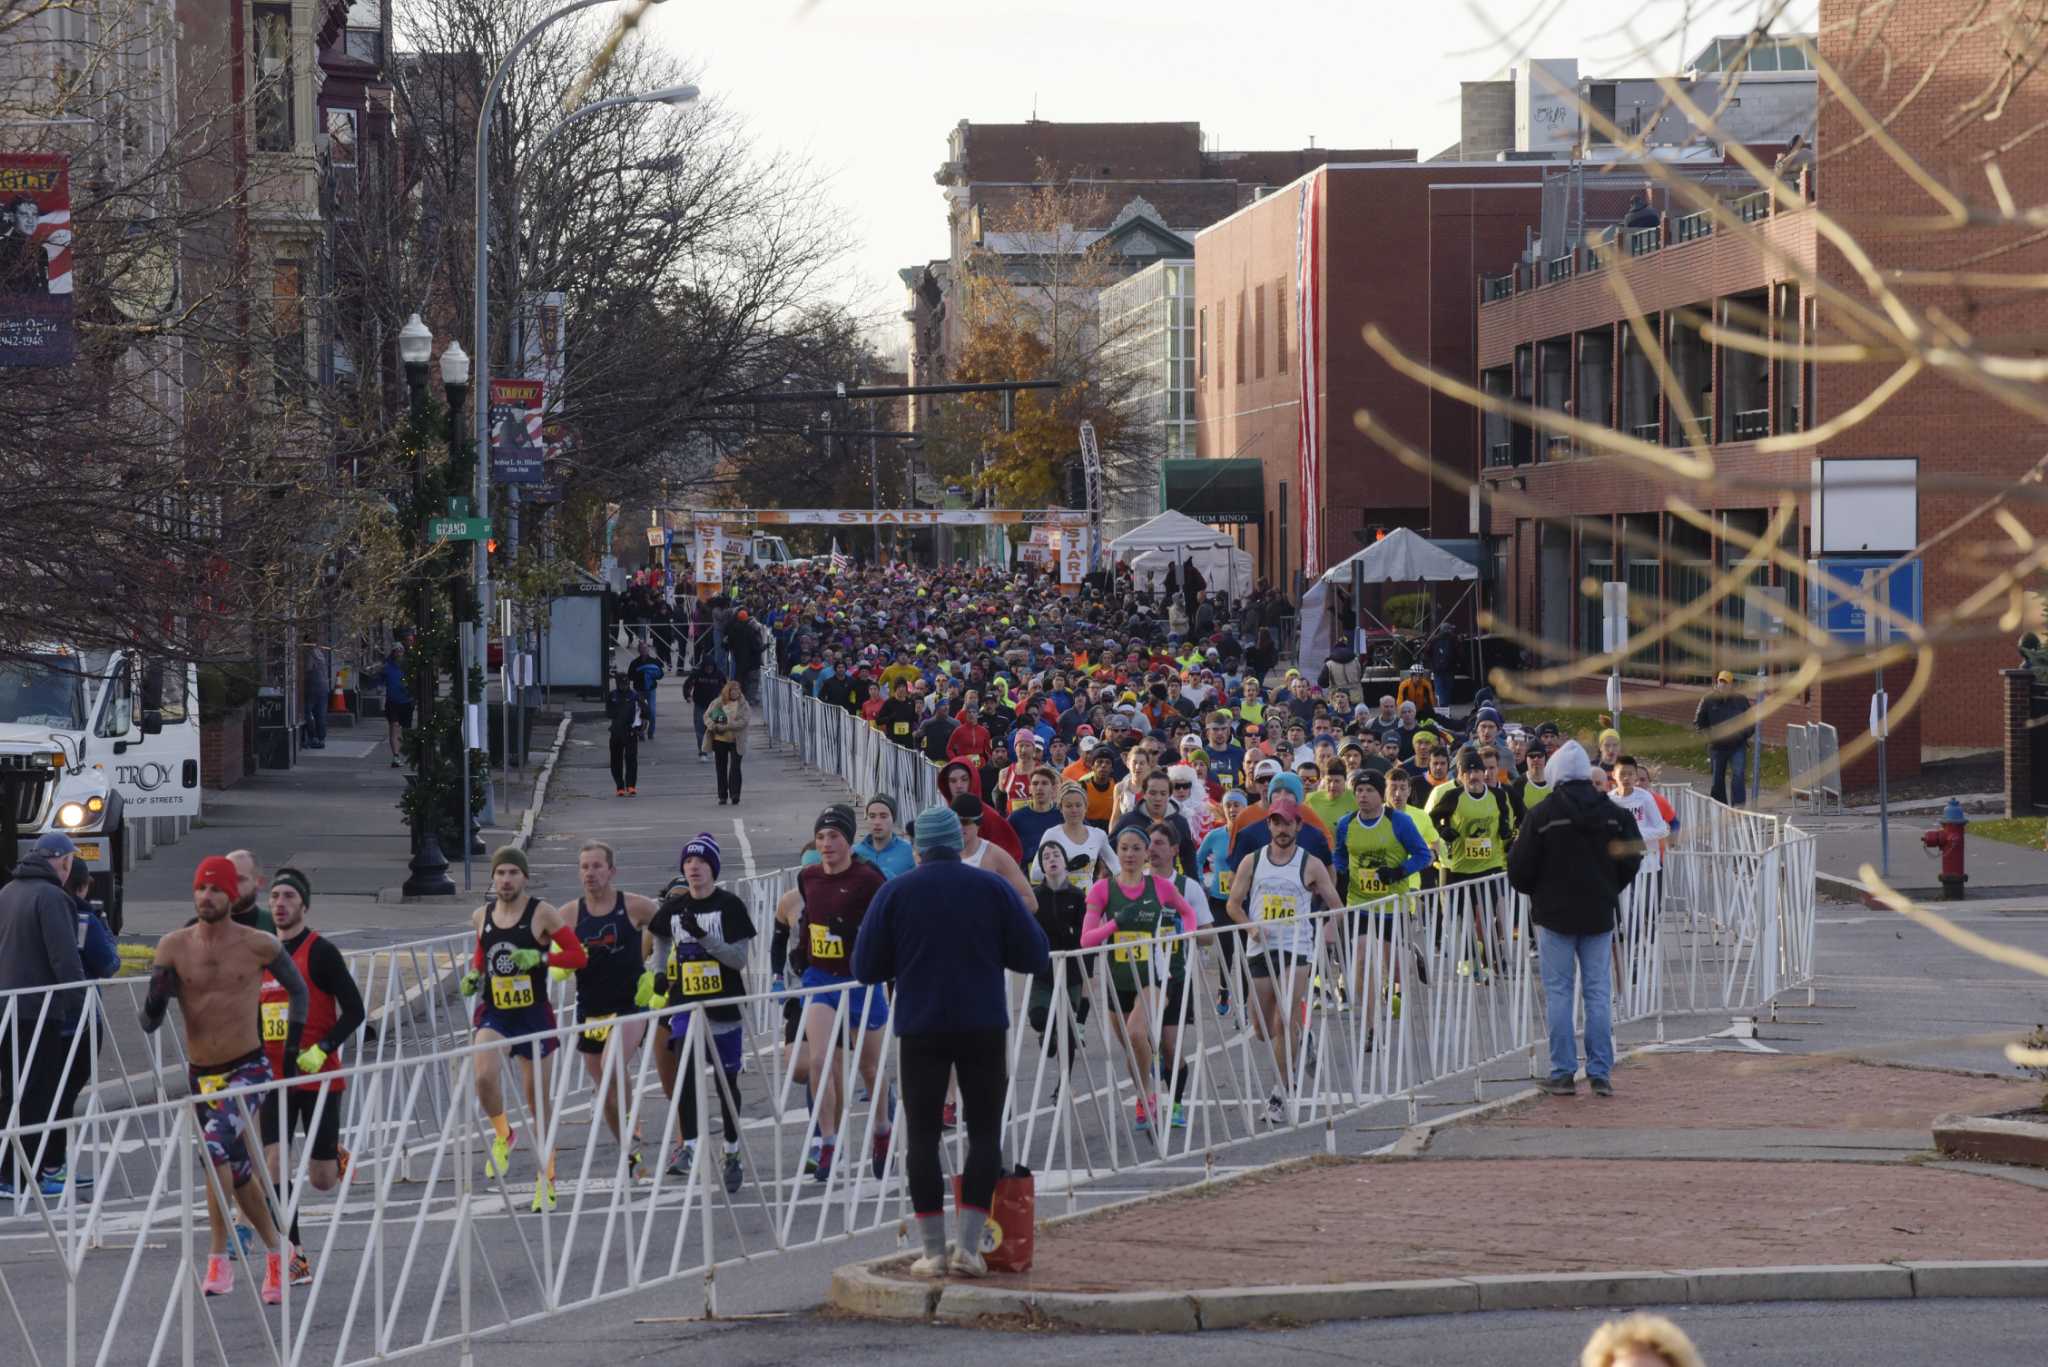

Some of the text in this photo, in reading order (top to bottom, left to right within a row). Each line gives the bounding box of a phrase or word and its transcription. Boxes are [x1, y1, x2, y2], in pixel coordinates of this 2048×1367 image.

[837, 511, 943, 523] START
[1219, 513, 1248, 522] BINGO
[436, 523, 466, 535] GRAND
[702, 527, 716, 581] START
[1066, 528, 1080, 584] START
[115, 761, 175, 791] TROY
[136, 797, 148, 805] OF
[150, 796, 184, 804] STREETS
[1466, 847, 1491, 858] 1545
[812, 939, 841, 955] 1371
[684, 975, 721, 992] 1388
[495, 989, 532, 1006] 1448
